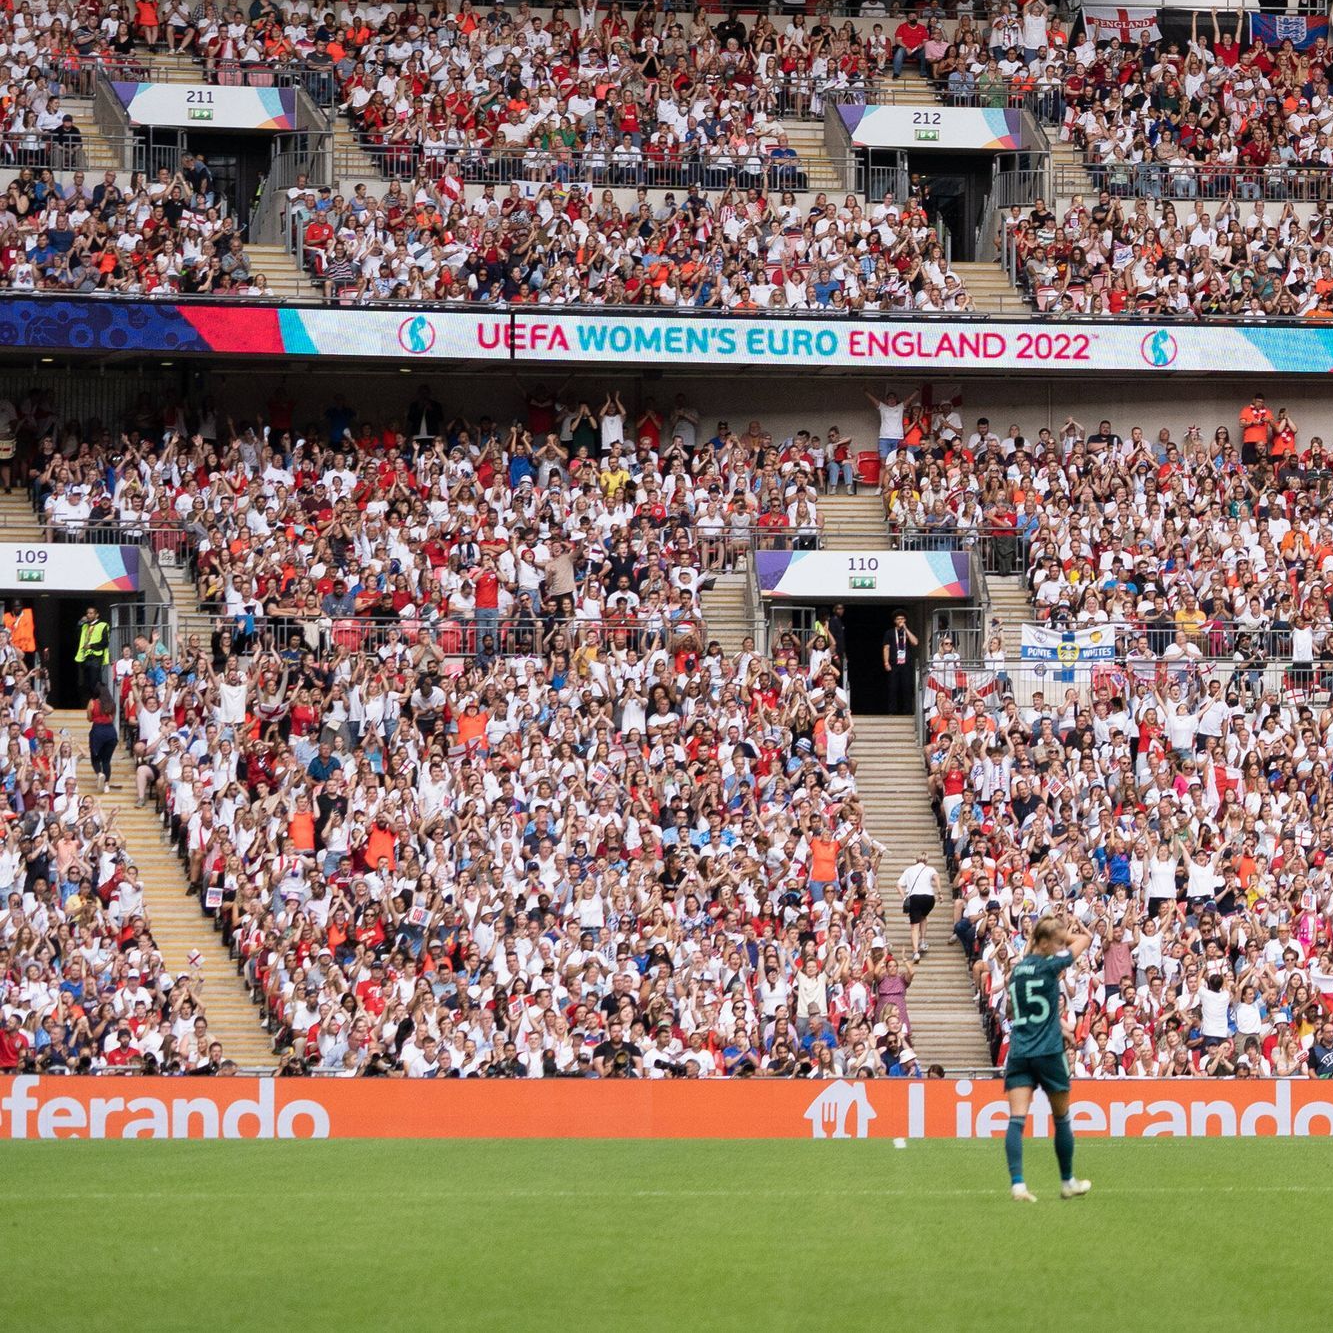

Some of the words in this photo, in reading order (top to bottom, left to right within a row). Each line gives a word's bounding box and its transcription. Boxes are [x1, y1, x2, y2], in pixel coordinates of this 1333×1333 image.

[1099, 19, 1150, 29] ENGLAND
[186, 90, 214, 104] 211
[913, 112, 941, 125] 212
[478, 322, 570, 350] UEFA
[578, 326, 736, 355] WOMEN'S
[748, 329, 838, 357] EURO
[849, 330, 1006, 359] ENGLAND
[15, 550, 48, 564] 109
[848, 557, 879, 571] 110
[1027, 648, 1052, 658] PONTE
[1083, 647, 1111, 657] WHITES
[1009, 979, 1050, 1026] 15
[0, 1074, 330, 1139] ferando
